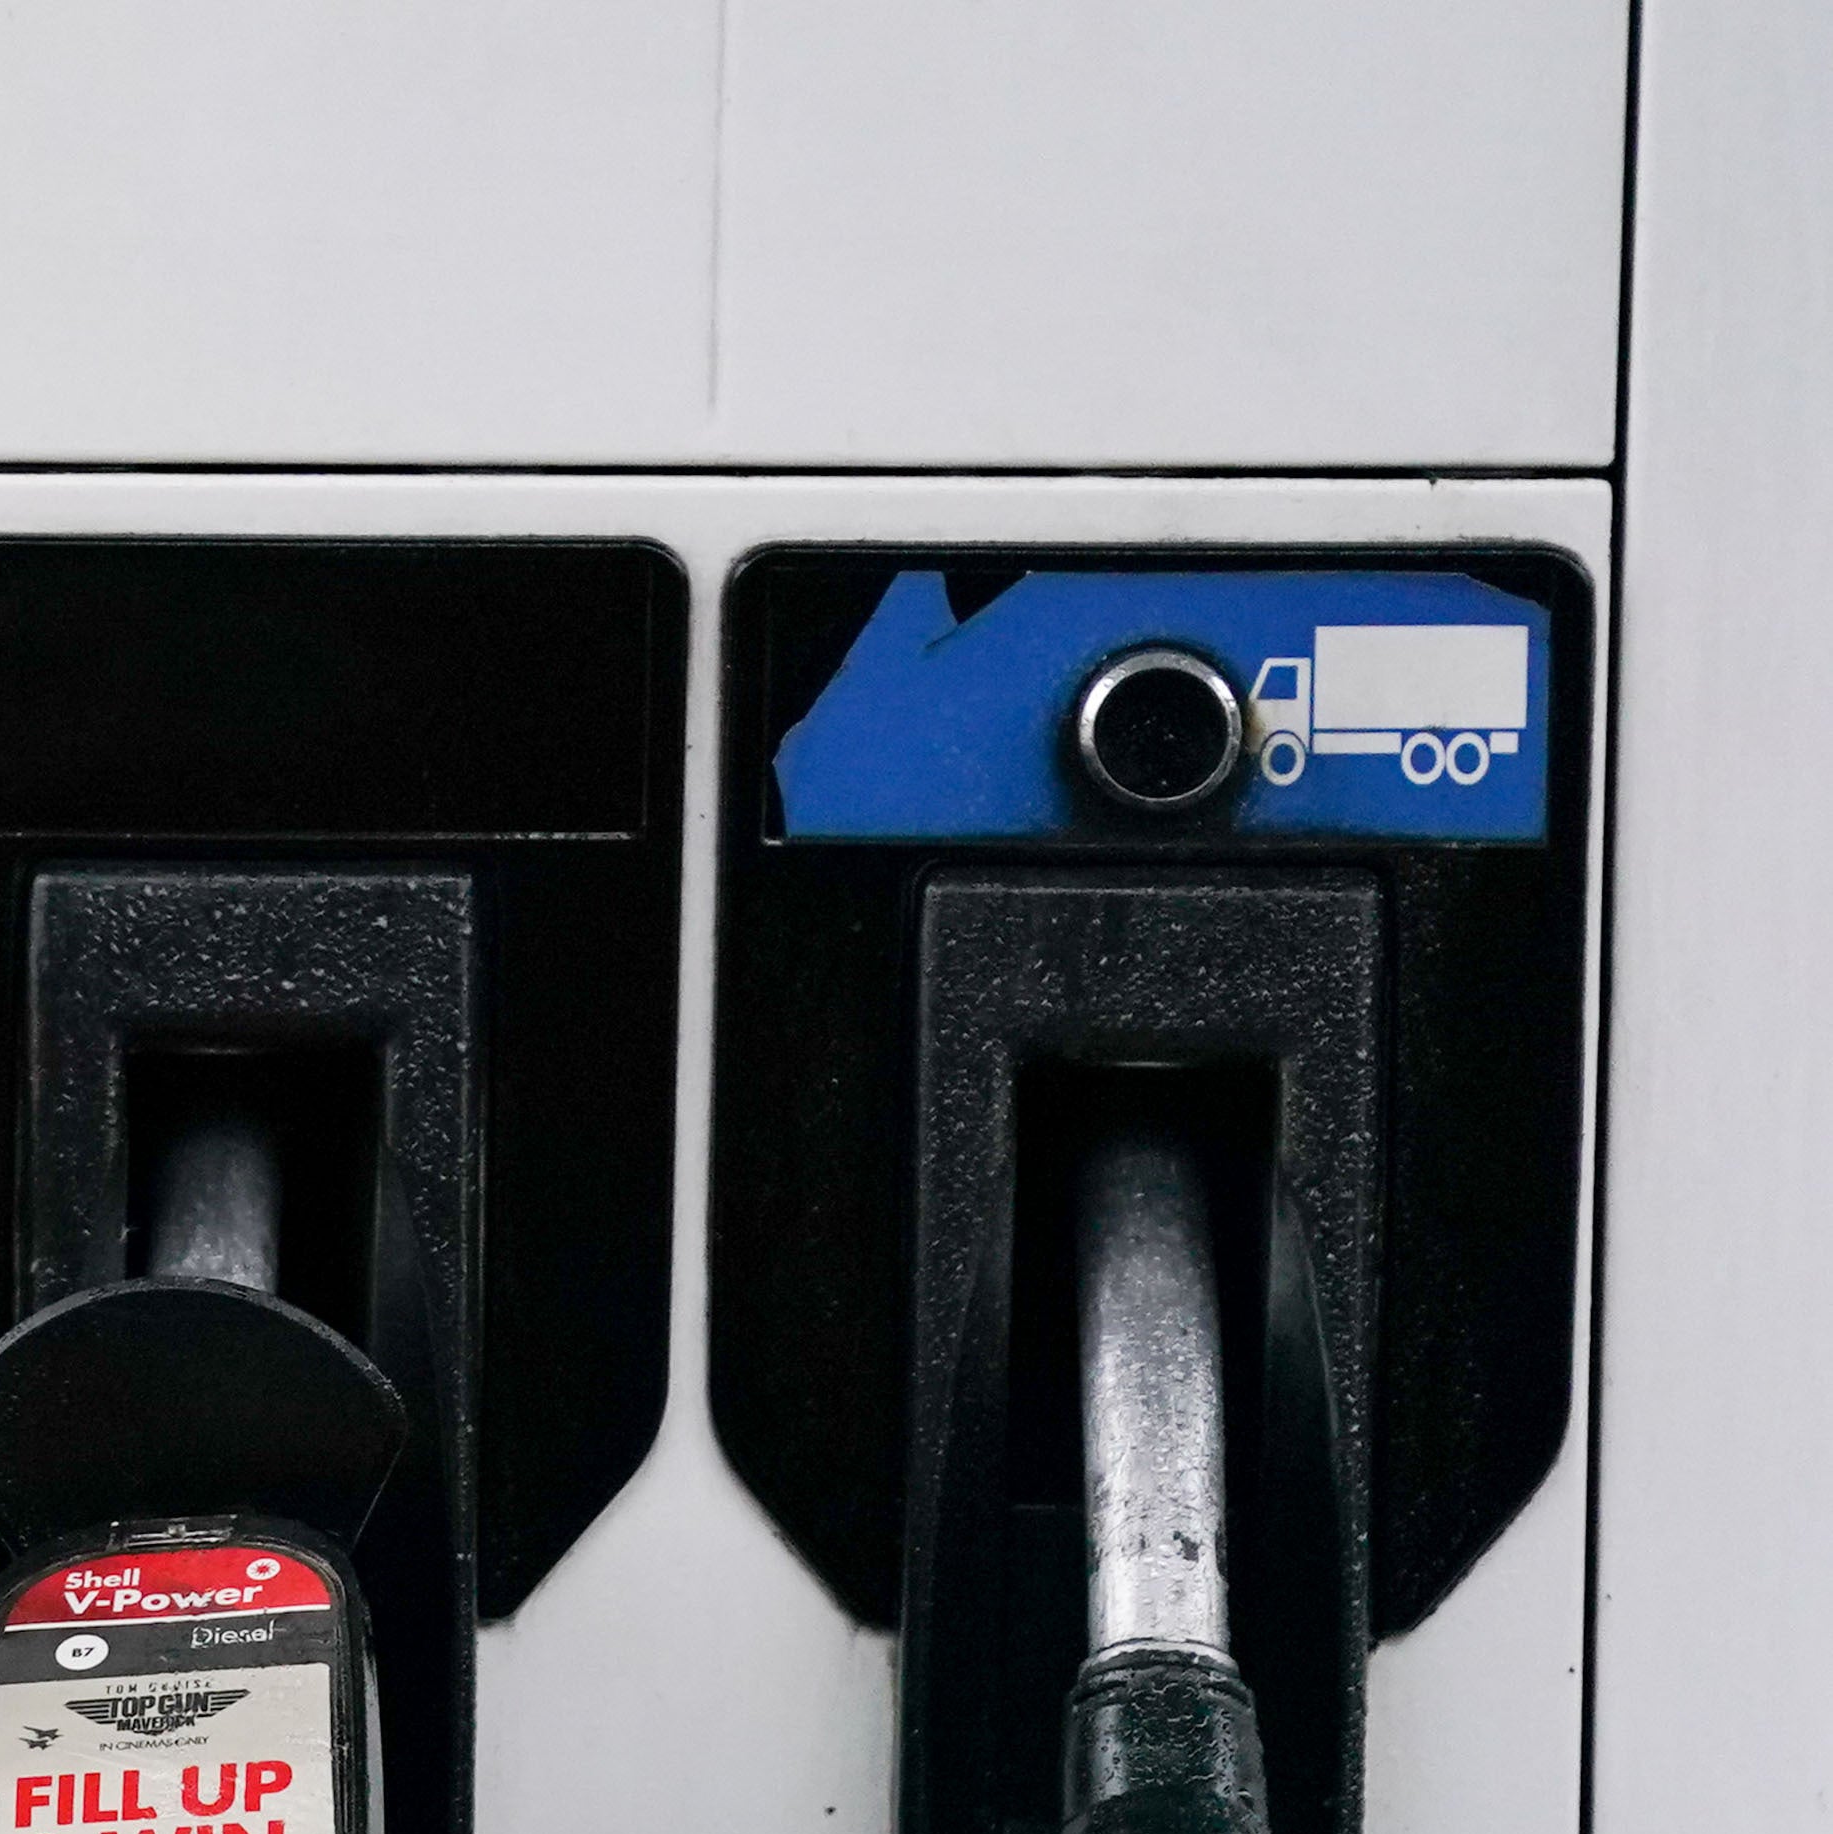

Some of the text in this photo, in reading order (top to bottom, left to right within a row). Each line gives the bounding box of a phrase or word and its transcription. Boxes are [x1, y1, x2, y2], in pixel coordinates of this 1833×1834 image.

[64, 1568, 141, 1589] Shell
[64, 1585, 263, 1615] V-Power
[191, 1620, 275, 1649] Diesel
[72, 1647, 95, 1658] B7
[109, 1691, 212, 1719] TOP GUN
[99, 1742, 113, 1751] IN
[15, 1770, 158, 1829] FILL
[181, 1760, 293, 1817] UP
